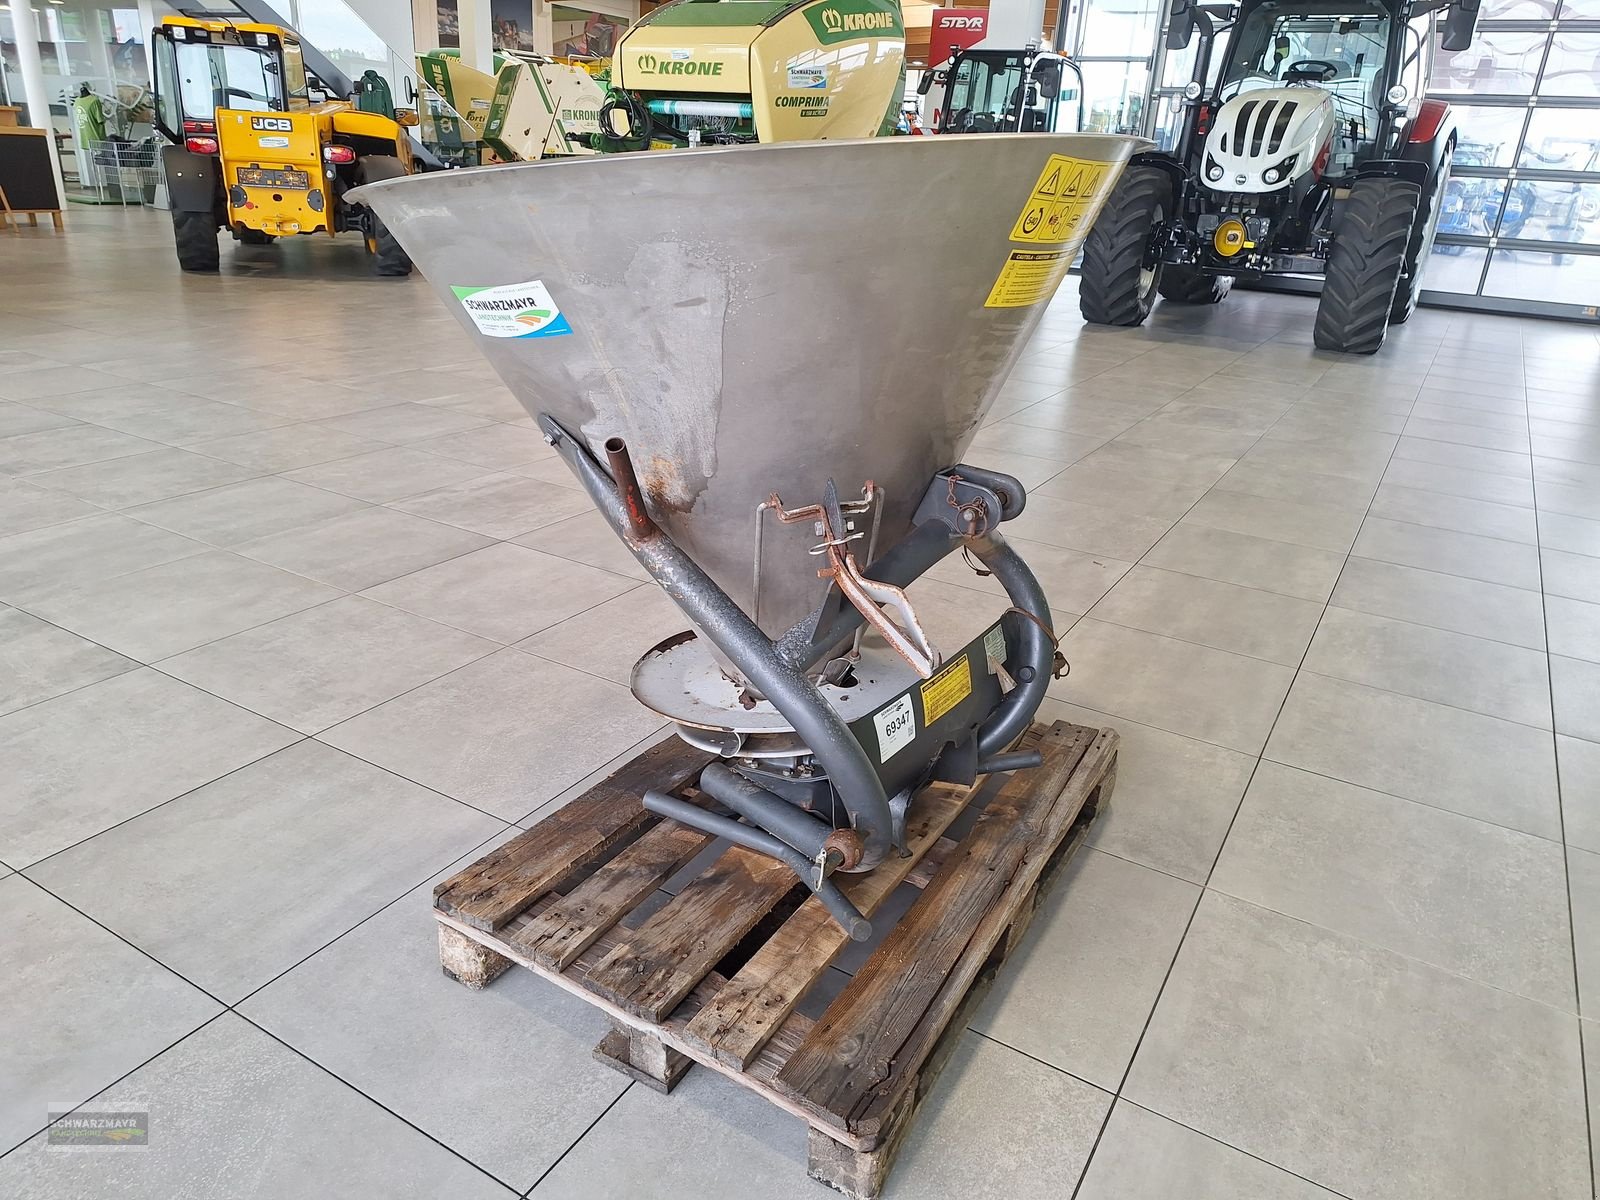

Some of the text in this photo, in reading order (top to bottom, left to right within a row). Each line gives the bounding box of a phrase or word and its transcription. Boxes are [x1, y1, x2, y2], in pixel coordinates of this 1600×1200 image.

[844, 12, 893, 31] KRONE
[939, 16, 984, 28] STEYR
[658, 61, 724, 76] KRONE
[775, 96, 830, 107] COMPRIMA
[573, 110, 600, 120] KRONE
[252, 118, 292, 131] JCB
[465, 297, 537, 312] SCHWARZMAYR
[886, 710, 910, 737] 69347
